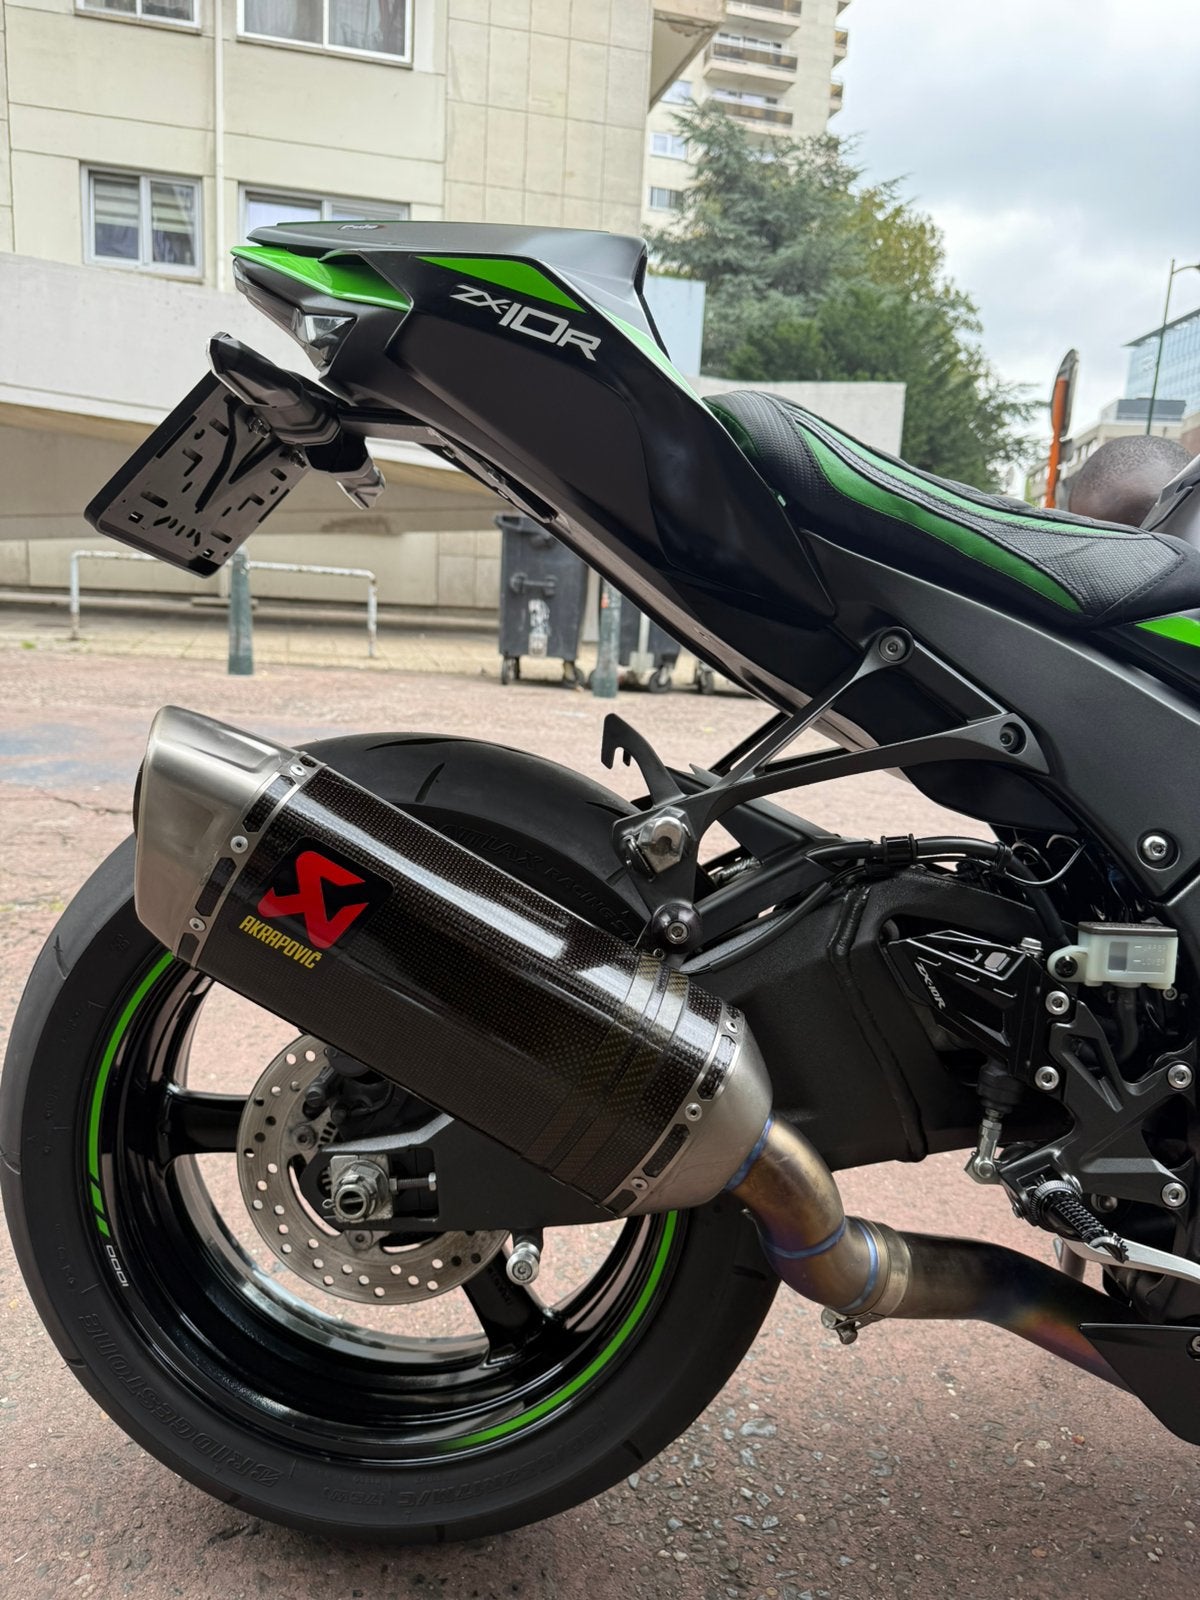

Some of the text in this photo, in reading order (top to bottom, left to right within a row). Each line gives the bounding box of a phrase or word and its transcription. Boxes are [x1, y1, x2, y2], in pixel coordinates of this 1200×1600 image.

[451, 285, 601, 361] ZX-10R
[429, 817, 543, 871] ATTLAX
[914, 961, 946, 1010] ZX-10R
[106, 1244, 129, 1287] 1000
[77, 1312, 283, 1489] BRIDGESTONE
